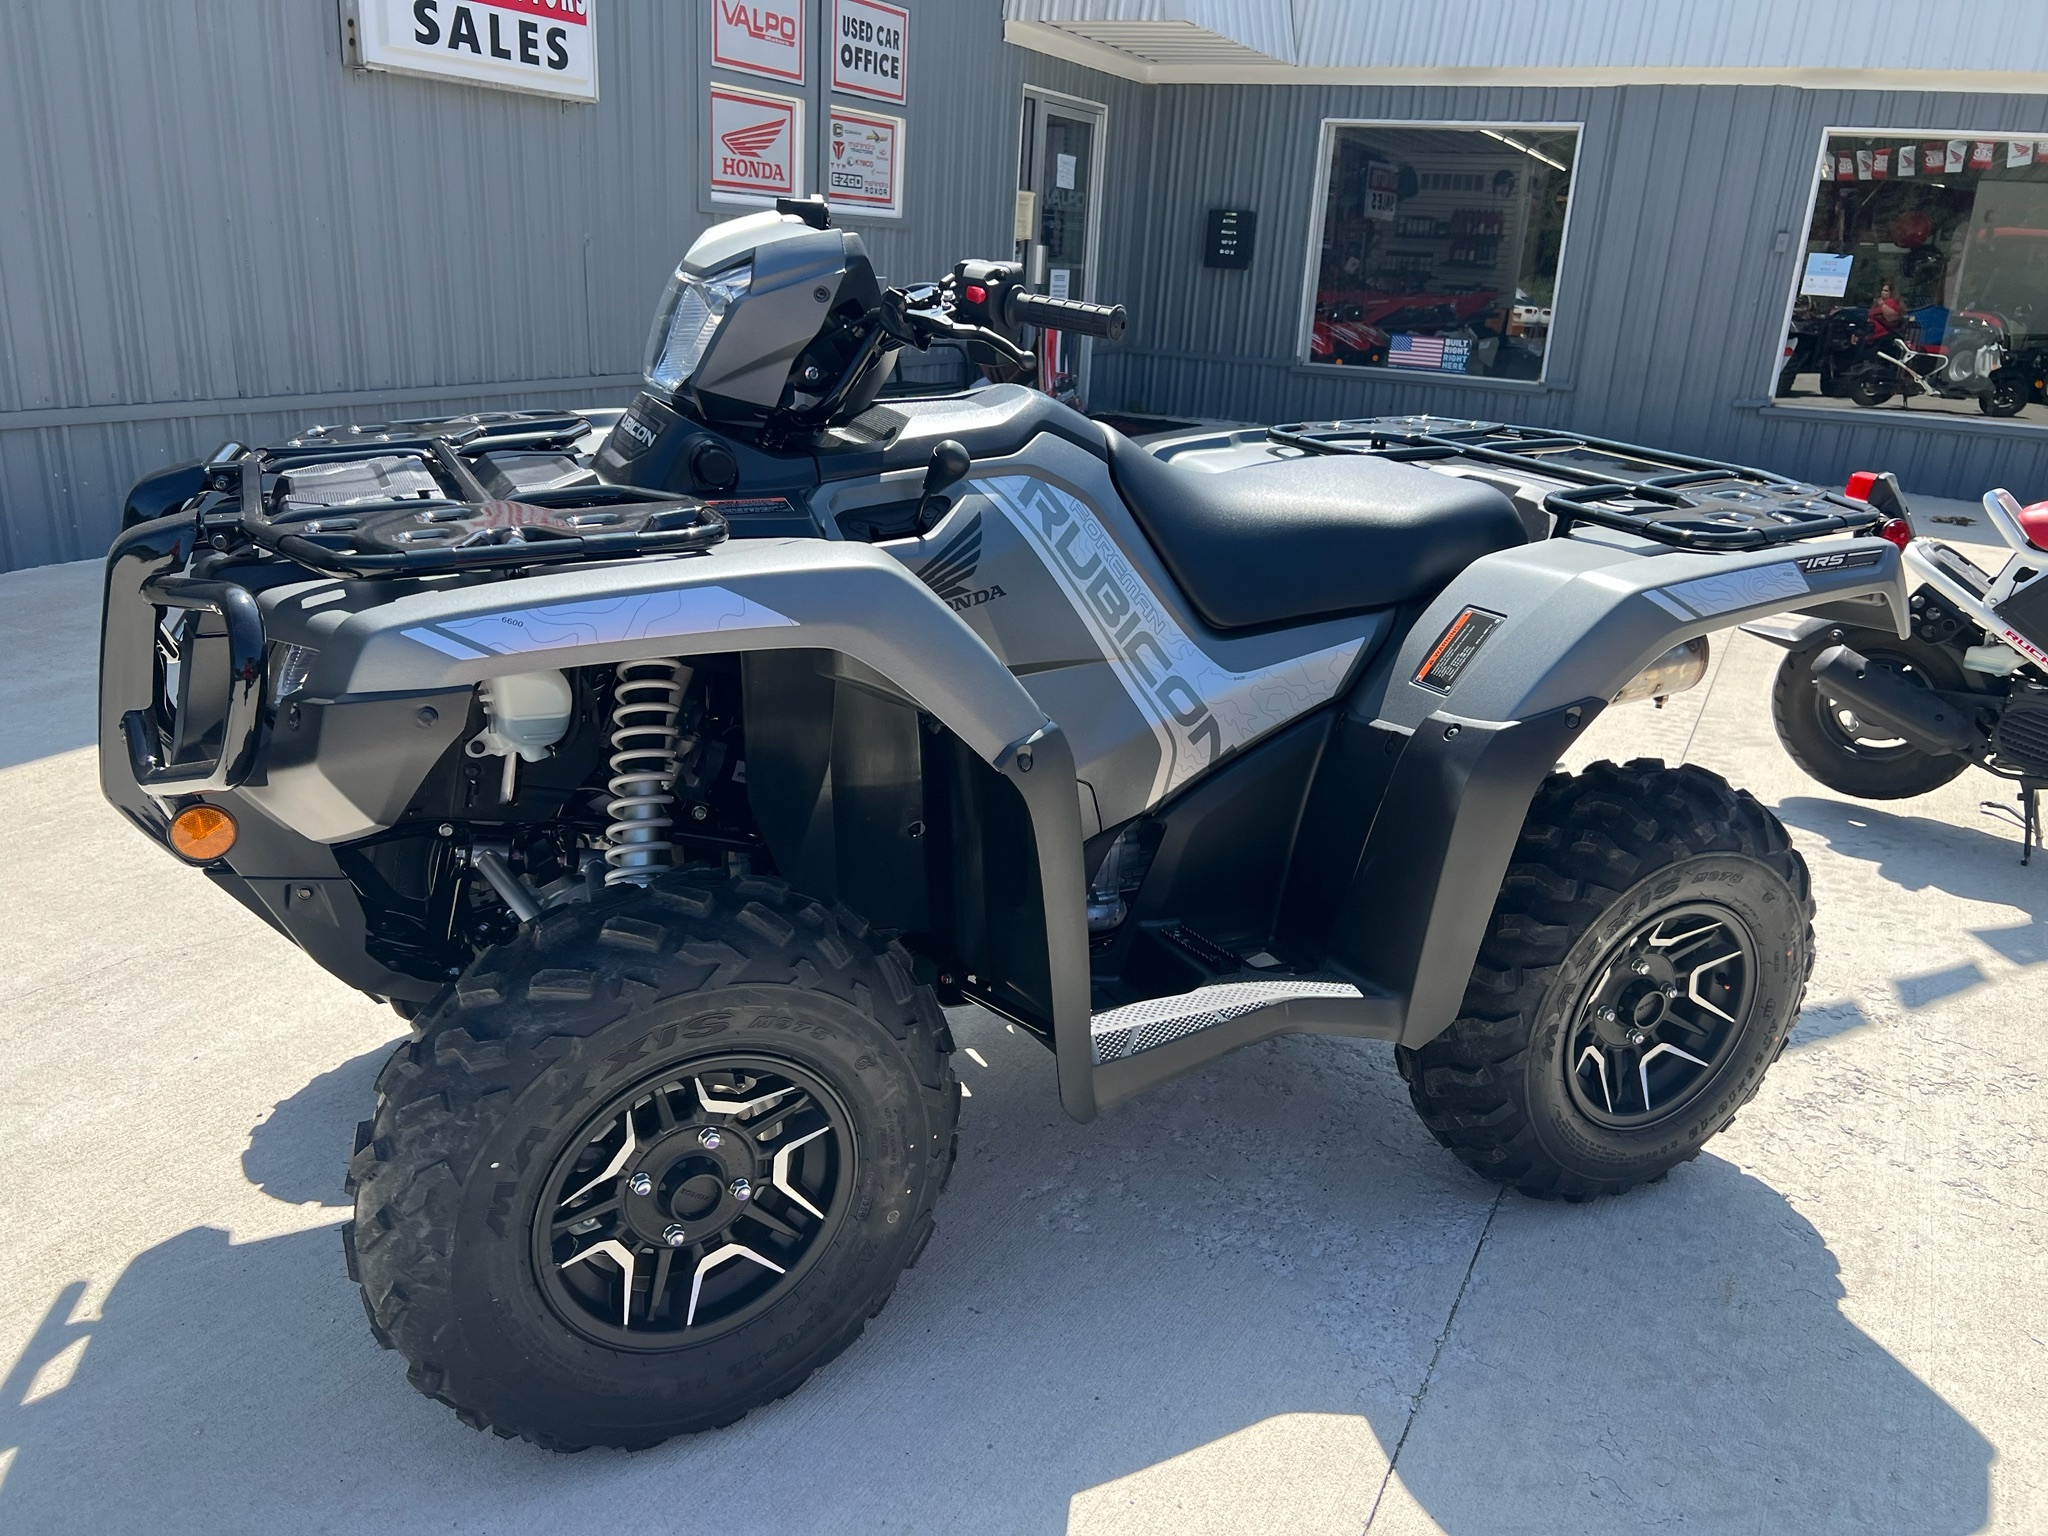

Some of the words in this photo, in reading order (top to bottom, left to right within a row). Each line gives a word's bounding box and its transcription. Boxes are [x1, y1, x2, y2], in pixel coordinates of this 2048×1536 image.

[721, 0, 796, 42] VALPO
[842, 15, 873, 43] USED
[877, 25, 900, 51] CAR
[413, 0, 568, 70] SALES
[764, 35, 791, 46] Motors
[840, 43, 900, 80] OFFICE
[722, 157, 785, 181] HONDA
[832, 172, 862, 188] EZGO
[864, 187, 888, 195] ROXOR
[1444, 346, 1470, 356] RIGHT.
[1445, 338, 1469, 347] BUILT
[1441, 361, 1466, 371] HERE.
[1443, 354, 1468, 363] RIGHT
[620, 413, 657, 447] UBICON
[1067, 498, 1166, 636] FOREMAN
[1806, 554, 1846, 569] IRS
[946, 585, 1007, 612] NDA
[501, 616, 524, 628] 6600
[1017, 476, 1238, 774] RUBICON
[1434, 625, 1460, 657] WARNING
[1541, 877, 1682, 1064] MAXXIS
[485, 1012, 734, 1239] MAXXIS
[750, 1015, 832, 1041] M975
